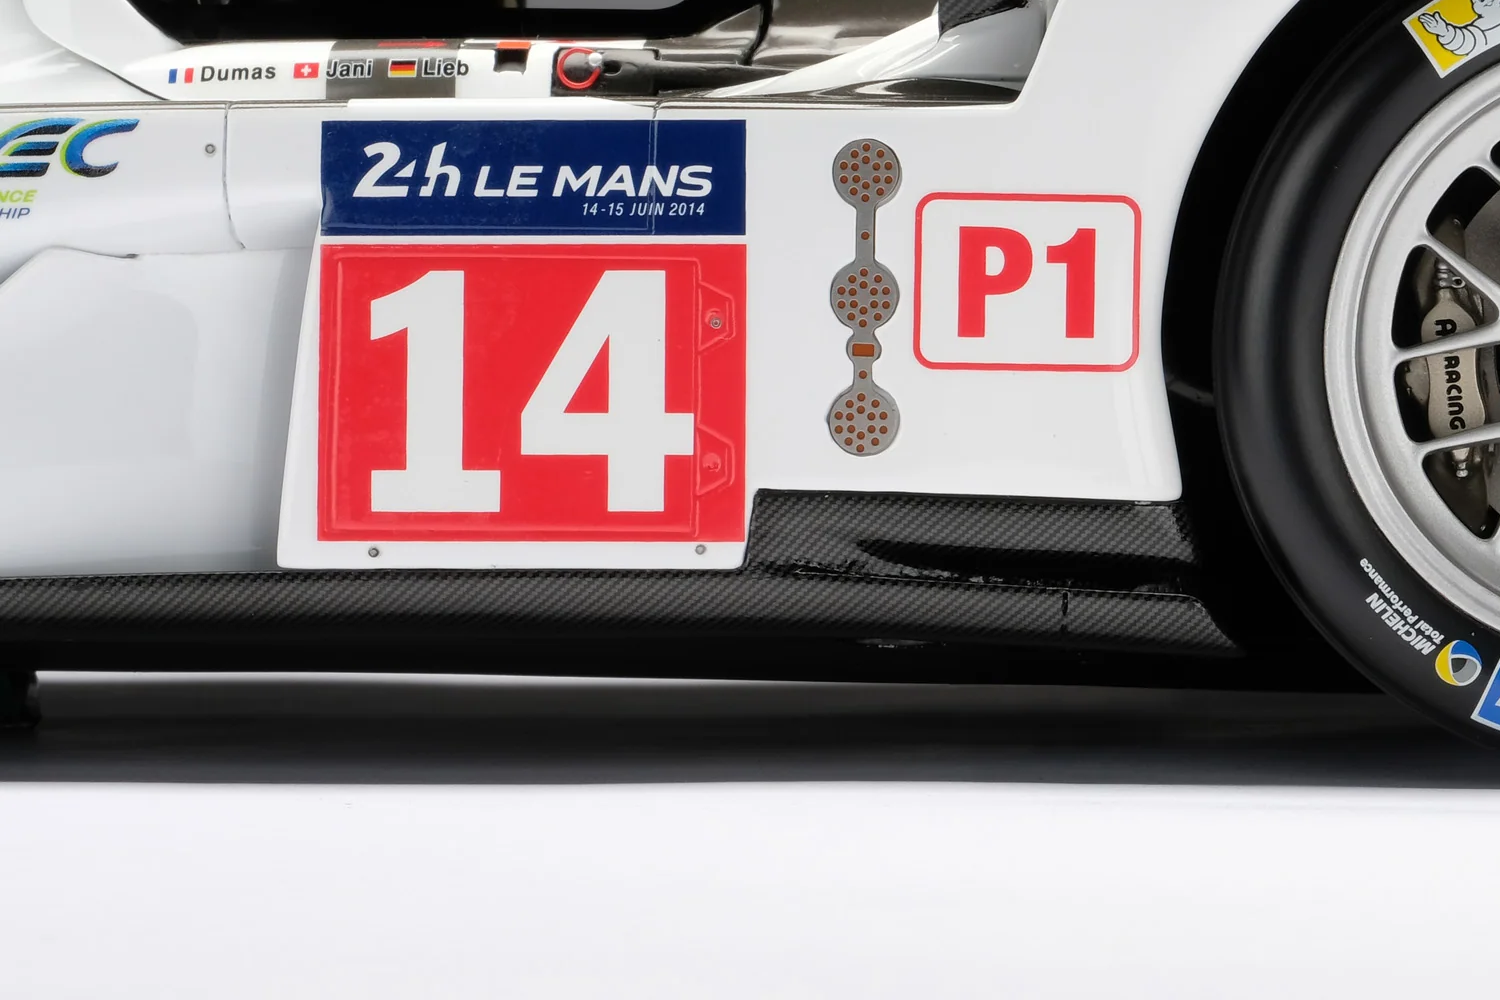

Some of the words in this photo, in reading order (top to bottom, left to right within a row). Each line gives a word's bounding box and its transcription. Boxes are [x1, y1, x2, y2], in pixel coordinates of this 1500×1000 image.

[200, 65, 276, 82] Dumas
[326, 59, 373, 79] Jani
[423, 58, 469, 77] Lieb
[473, 165, 543, 197] LE
[552, 165, 713, 197] MANS
[582, 202, 624, 216] 14-15
[629, 202, 664, 216] JUIN
[668, 202, 705, 216] 2014
[957, 226, 1097, 339] P1
[370, 269, 694, 513] 14
[1443, 355, 1466, 430] RACING
[1359, 558, 1419, 624] Performance
[1365, 592, 1437, 656] MICHELIN
[1414, 620, 1445, 645] Total
